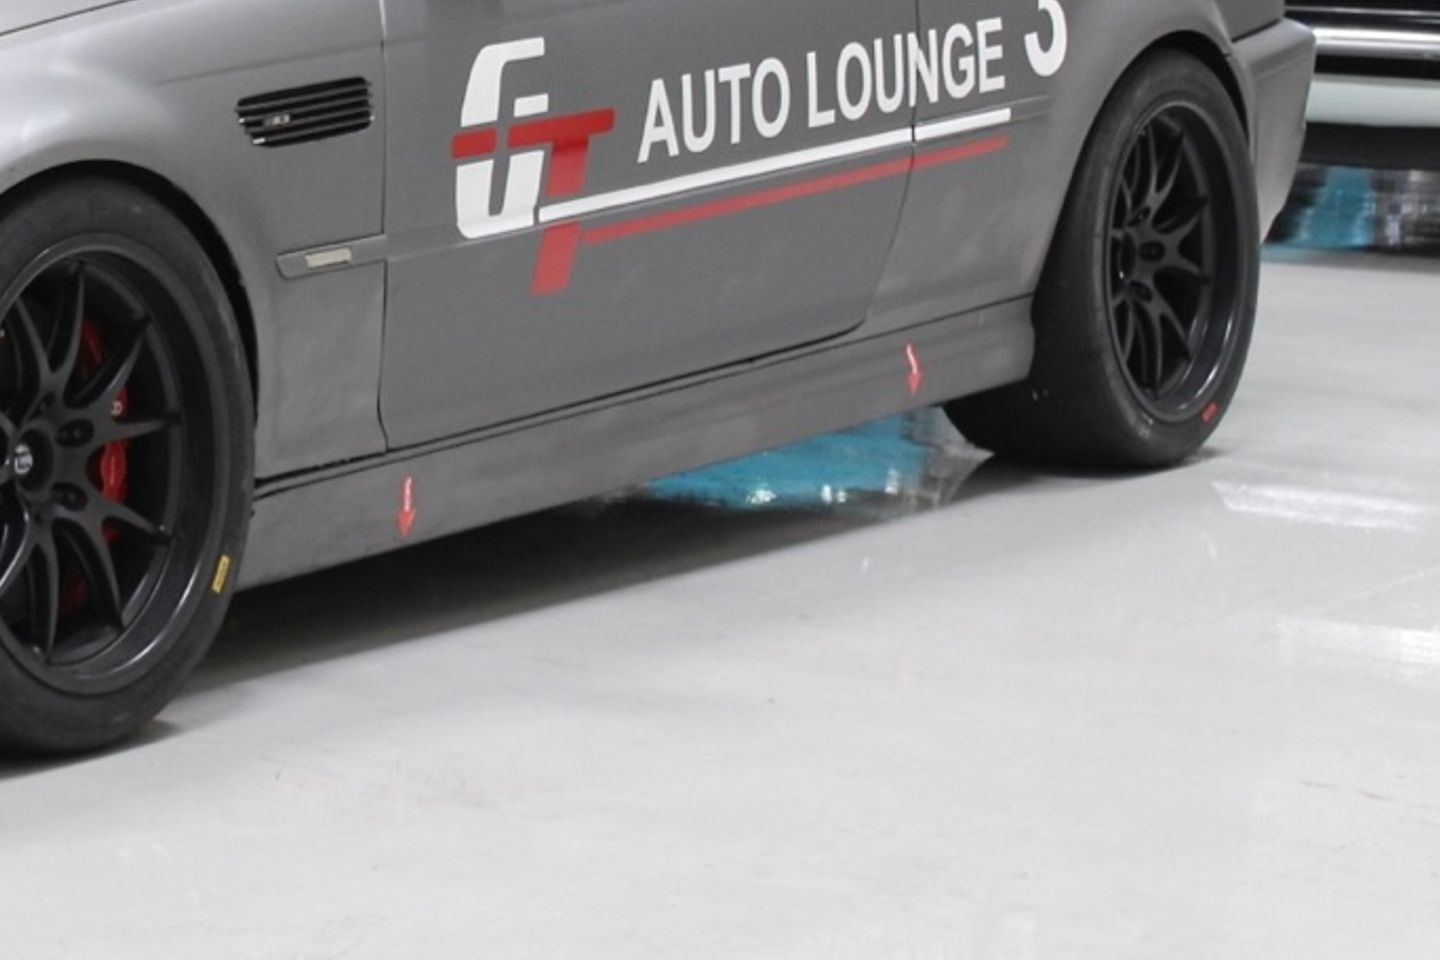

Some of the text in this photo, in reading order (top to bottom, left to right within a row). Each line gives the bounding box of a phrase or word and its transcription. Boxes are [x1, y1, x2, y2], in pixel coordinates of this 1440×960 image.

[451, 17, 1006, 296] GT AUTO LOUNGE
